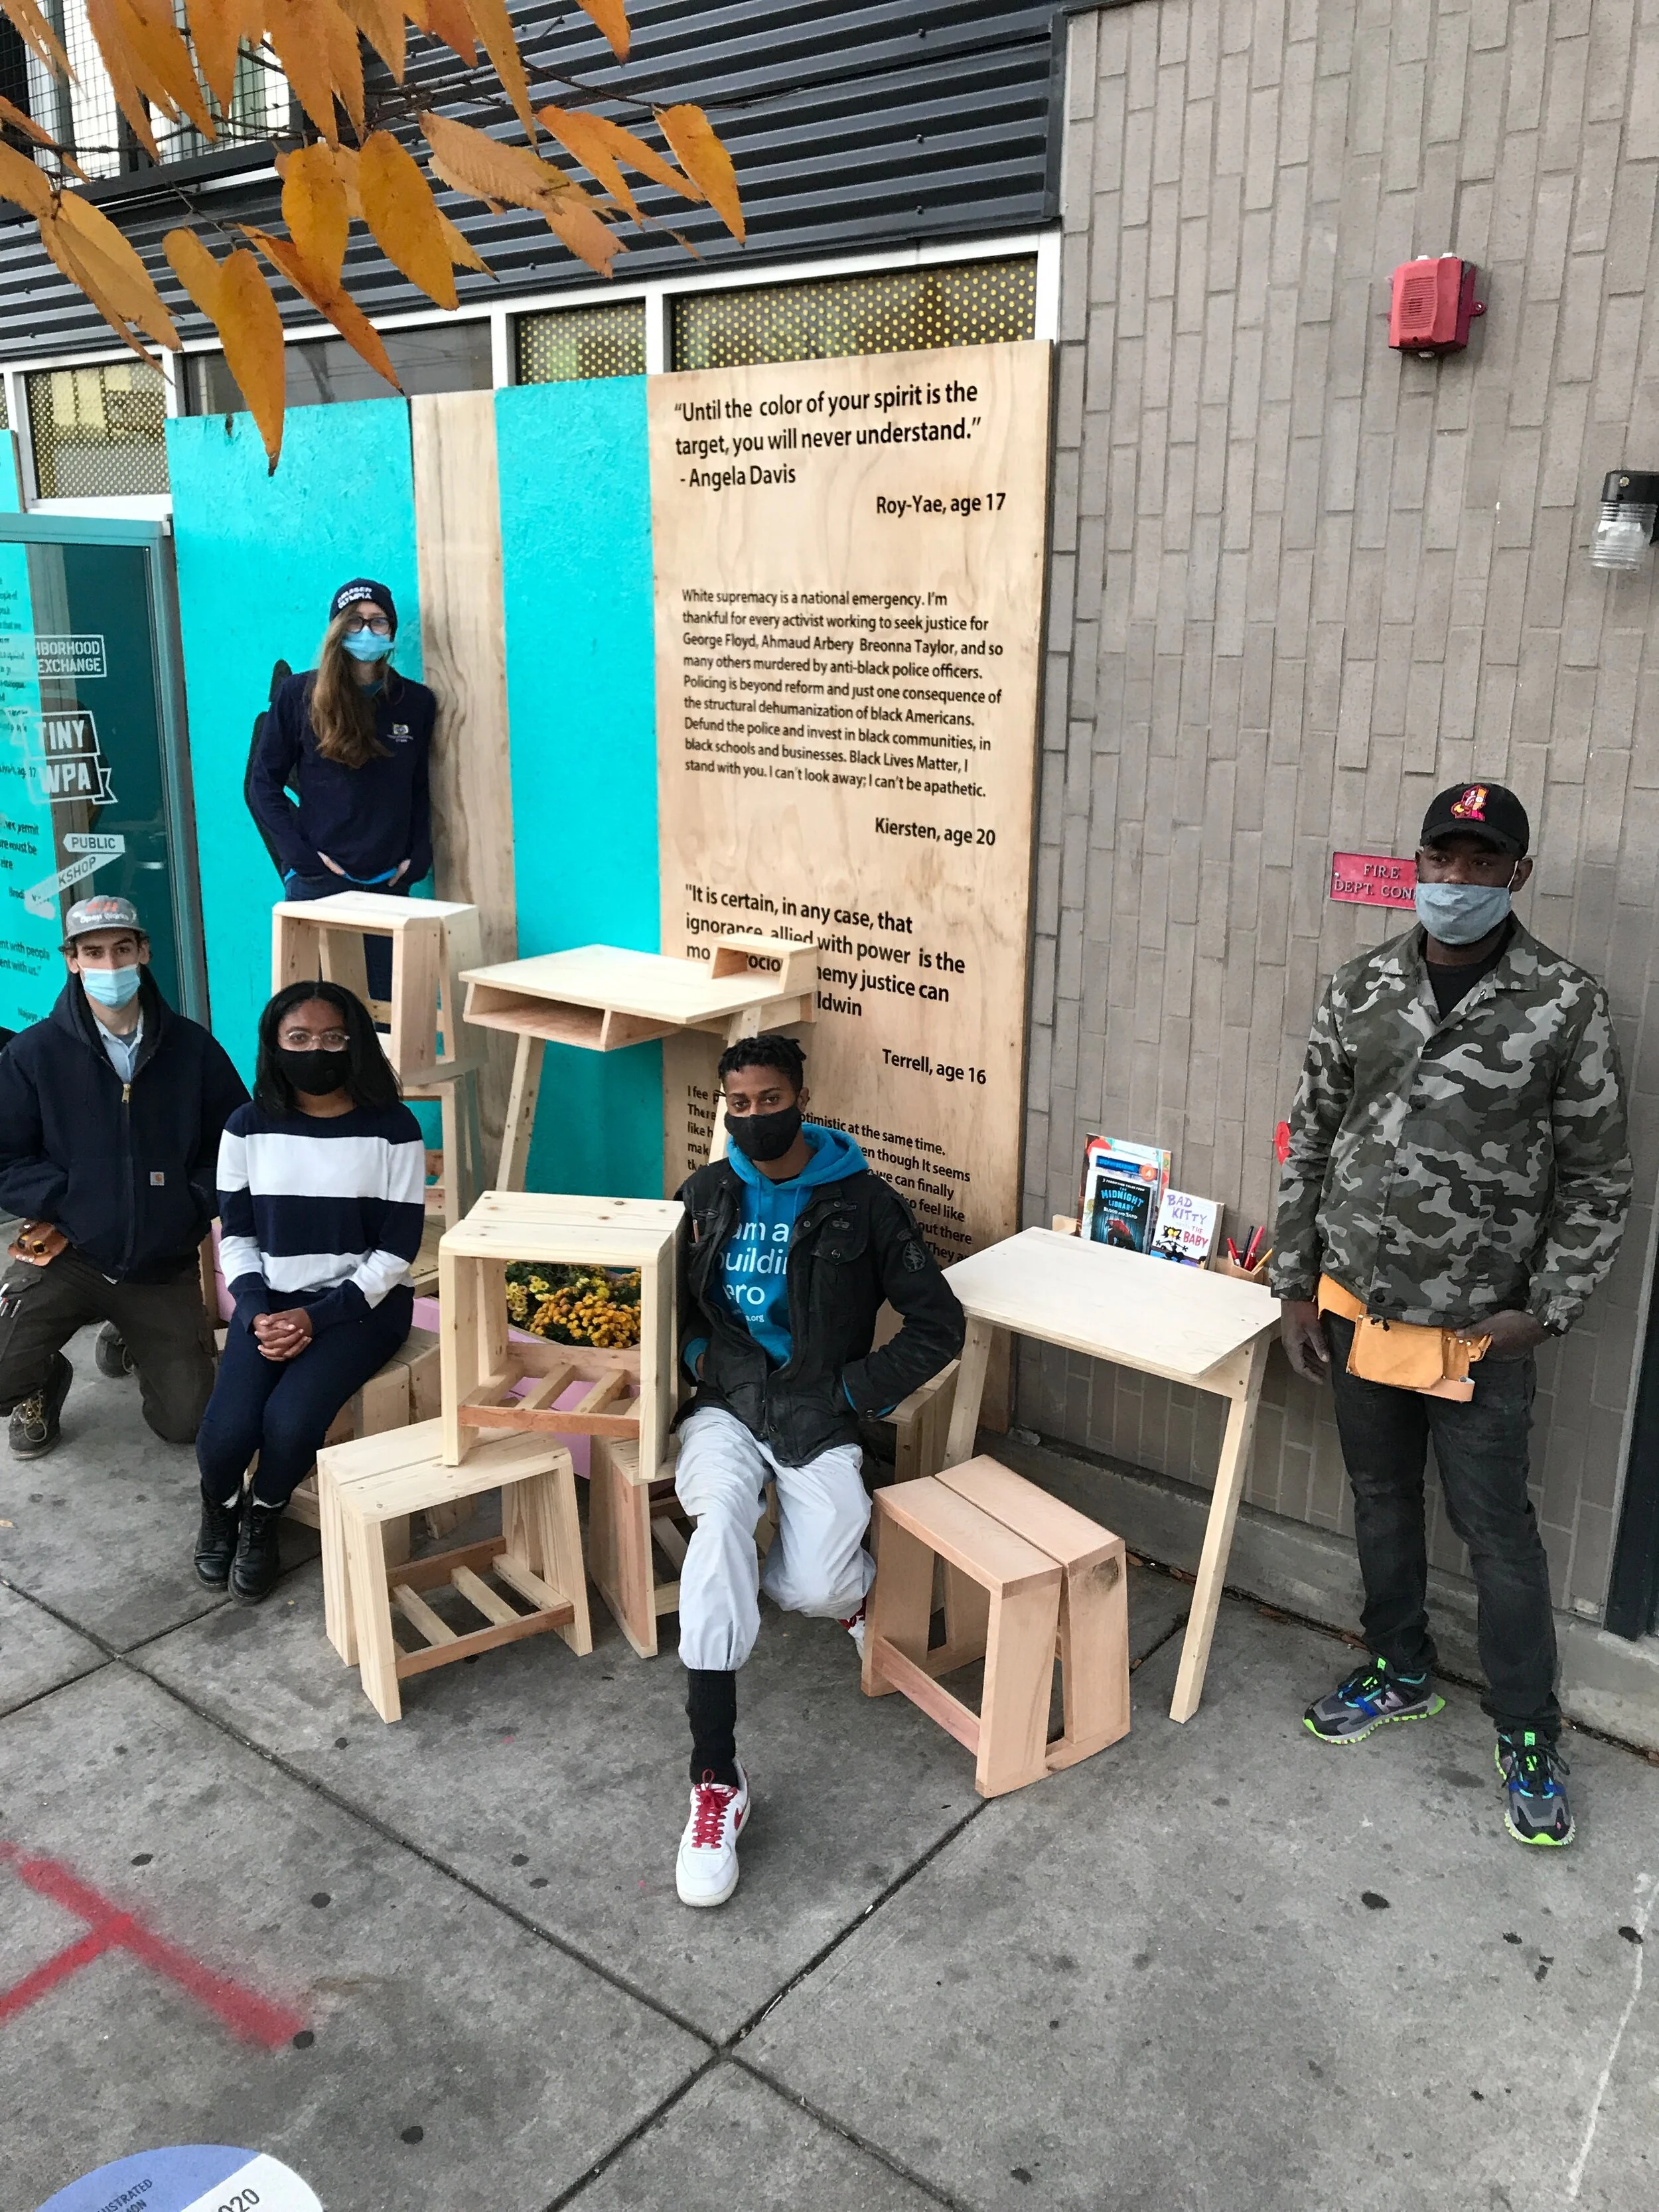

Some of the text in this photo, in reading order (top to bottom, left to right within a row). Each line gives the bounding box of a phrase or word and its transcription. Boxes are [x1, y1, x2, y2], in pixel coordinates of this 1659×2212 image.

[724, 398, 753, 419] the
[759, 394, 803, 417] color
[806, 390, 826, 413] of
[827, 393, 871, 418] your
[873, 383, 923, 414] spirit
[926, 382, 941, 405] is
[944, 380, 978, 404] the
[675, 435, 730, 460] target,
[732, 435, 764, 458] you
[766, 427, 798, 451] will
[801, 430, 852, 449] never
[688, 463, 796, 492] Angela Davis
[876, 492, 1007, 519] Roy-Yae, age 17
[682, 589, 925, 610] White supremacy is a national emergency.
[682, 610, 989, 634] thankful for every activist working to seek justice for
[36, 641, 100, 656] HBORHOOD
[682, 631, 723, 650] George
[760, 634, 811, 650] Ahmaud
[812, 636, 855, 655] Arbery
[859, 637, 912, 653] Breonna
[914, 638, 958, 658] Taylor,
[960, 639, 986, 656] and
[987, 644, 1004, 656] so
[38, 658, 101, 673] EXCHANGE
[683, 654, 983, 680] many others murdered by anti-black police officers.
[683, 674, 1003, 705] Policing is beyond reform and just one consequence of
[683, 695, 975, 727] the structural dehumanization of black Americans.
[34, 719, 84, 750] TINY
[684, 716, 991, 753] Defund the police and invest in black communities, in
[684, 737, 962, 774] black schools and businesses. Black Lives Matter,
[38, 763, 91, 793] WPA
[685, 759, 986, 798] stand with you. look away; be apathetic.
[71, 837, 115, 849] PUBLIC
[875, 816, 996, 848] Kiersten, age 20
[58, 856, 96, 886] KSHOP
[1364, 863, 1400, 879] FIRE
[1334, 879, 1415, 900] DEPT. CON
[705, 885, 718, 905] is
[720, 893, 779, 917] certain,
[782, 896, 798, 917] in
[800, 904, 831, 926] any
[833, 909, 875, 931] case,
[877, 910, 913, 934] that
[10, 941, 25, 953] with
[26, 946, 50, 960] people
[816, 933, 853, 956] with
[856, 942, 911, 964] power
[918, 946, 932, 968] is
[935, 950, 966, 974] the
[859, 969, 949, 1002] justice can
[881, 1048, 987, 1085] Terrell, age 16
[687, 1121, 705, 1136] like
[847, 1123, 946, 1156] at the same time.
[877, 1147, 920, 1171] though
[932, 1164, 971, 1183] seems
[895, 1175, 955, 1201] can finally
[1101, 1189, 1144, 1207] MIDNIGHT
[1167, 1195, 1192, 1207] BAD
[918, 1198, 941, 1216] feel
[943, 1204, 966, 1222] like
[1108, 1199, 1134, 1211] LIBRARY
[1172, 1207, 1208, 1225] KITTY
[772, 1223, 789, 1242] a
[939, 1226, 972, 1245] there
[1183, 1231, 1208, 1248] BABY
[719, 1248, 787, 1275] uildi
[723, 1283, 765, 1305] ero
